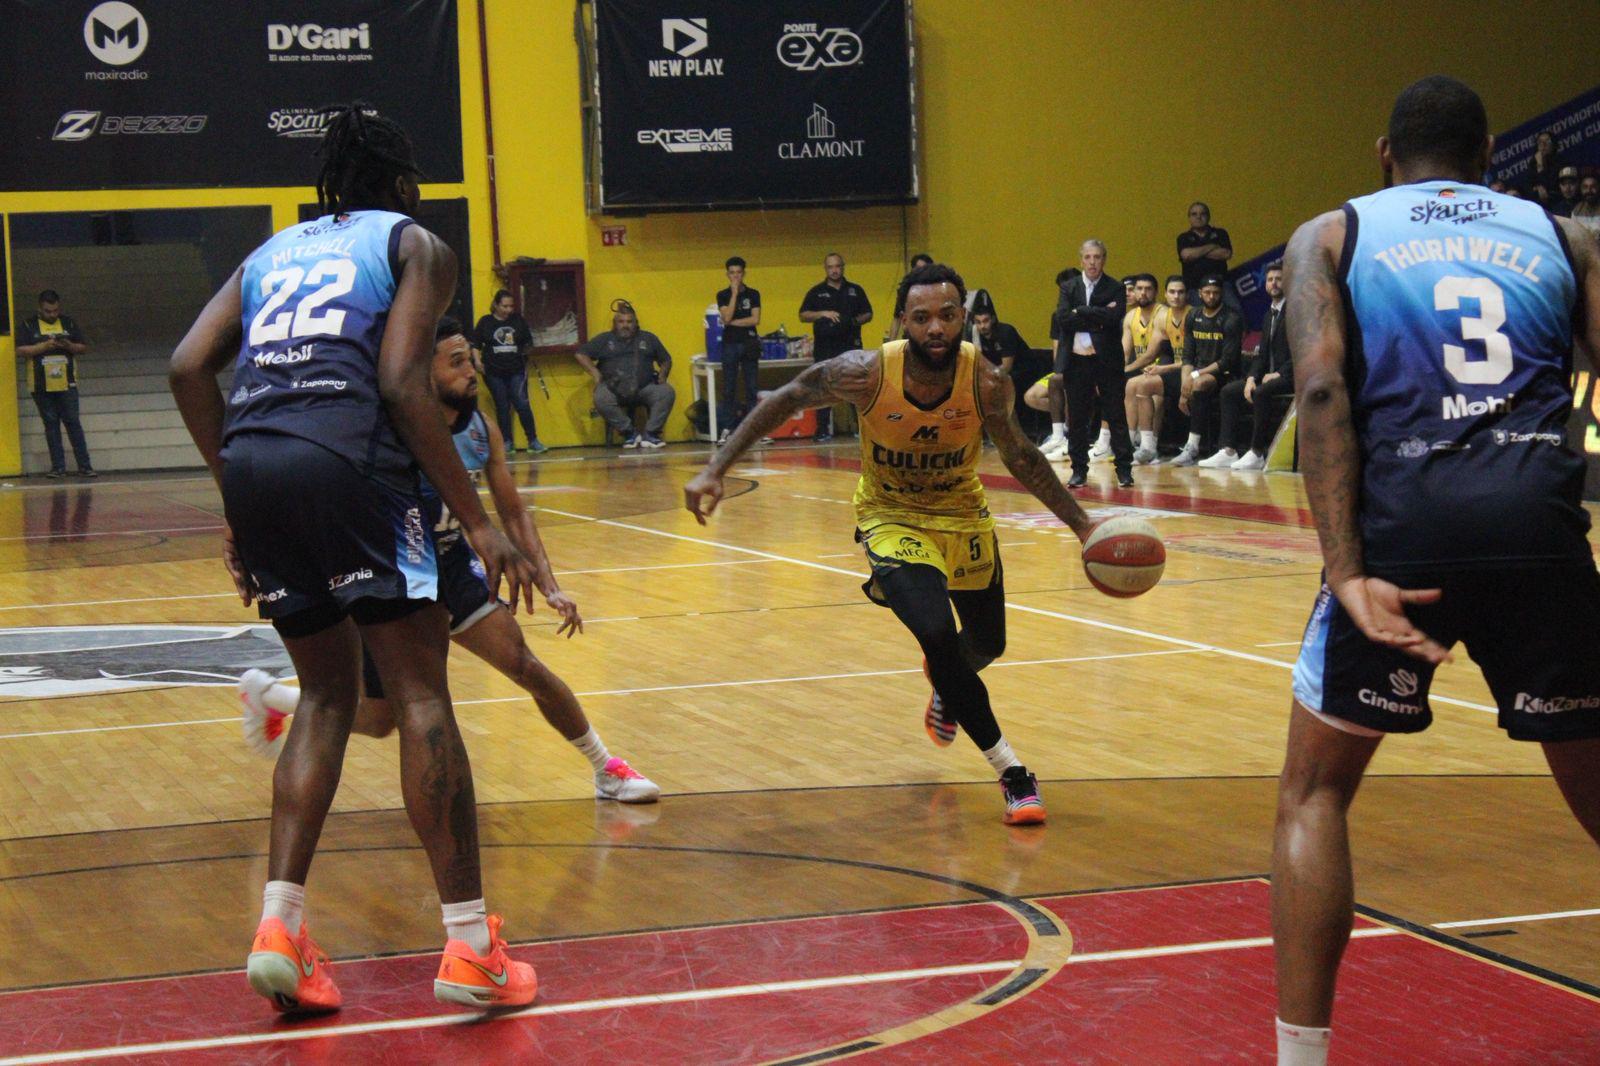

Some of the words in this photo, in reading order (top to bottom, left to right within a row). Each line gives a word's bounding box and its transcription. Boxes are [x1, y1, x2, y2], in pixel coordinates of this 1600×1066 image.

[267, 22, 370, 50] D'Gari
[783, 23, 817, 32] PONTE
[348, 54, 373, 62] postre
[649, 59, 681, 77] NEW
[685, 58, 724, 77] PLAY
[85, 69, 148, 80] maxiradio
[100, 115, 208, 134] DEZZO
[637, 128, 733, 149] EXTREME
[700, 143, 729, 152] GYM
[778, 140, 866, 159] CLAMONT
[272, 238, 357, 270] MITCHELL
[1374, 235, 1543, 283] THORNWELL
[249, 258, 358, 348] 22
[1433, 275, 1514, 385] 3
[253, 344, 316, 368] Mobil
[968, 534, 982, 561] 5
